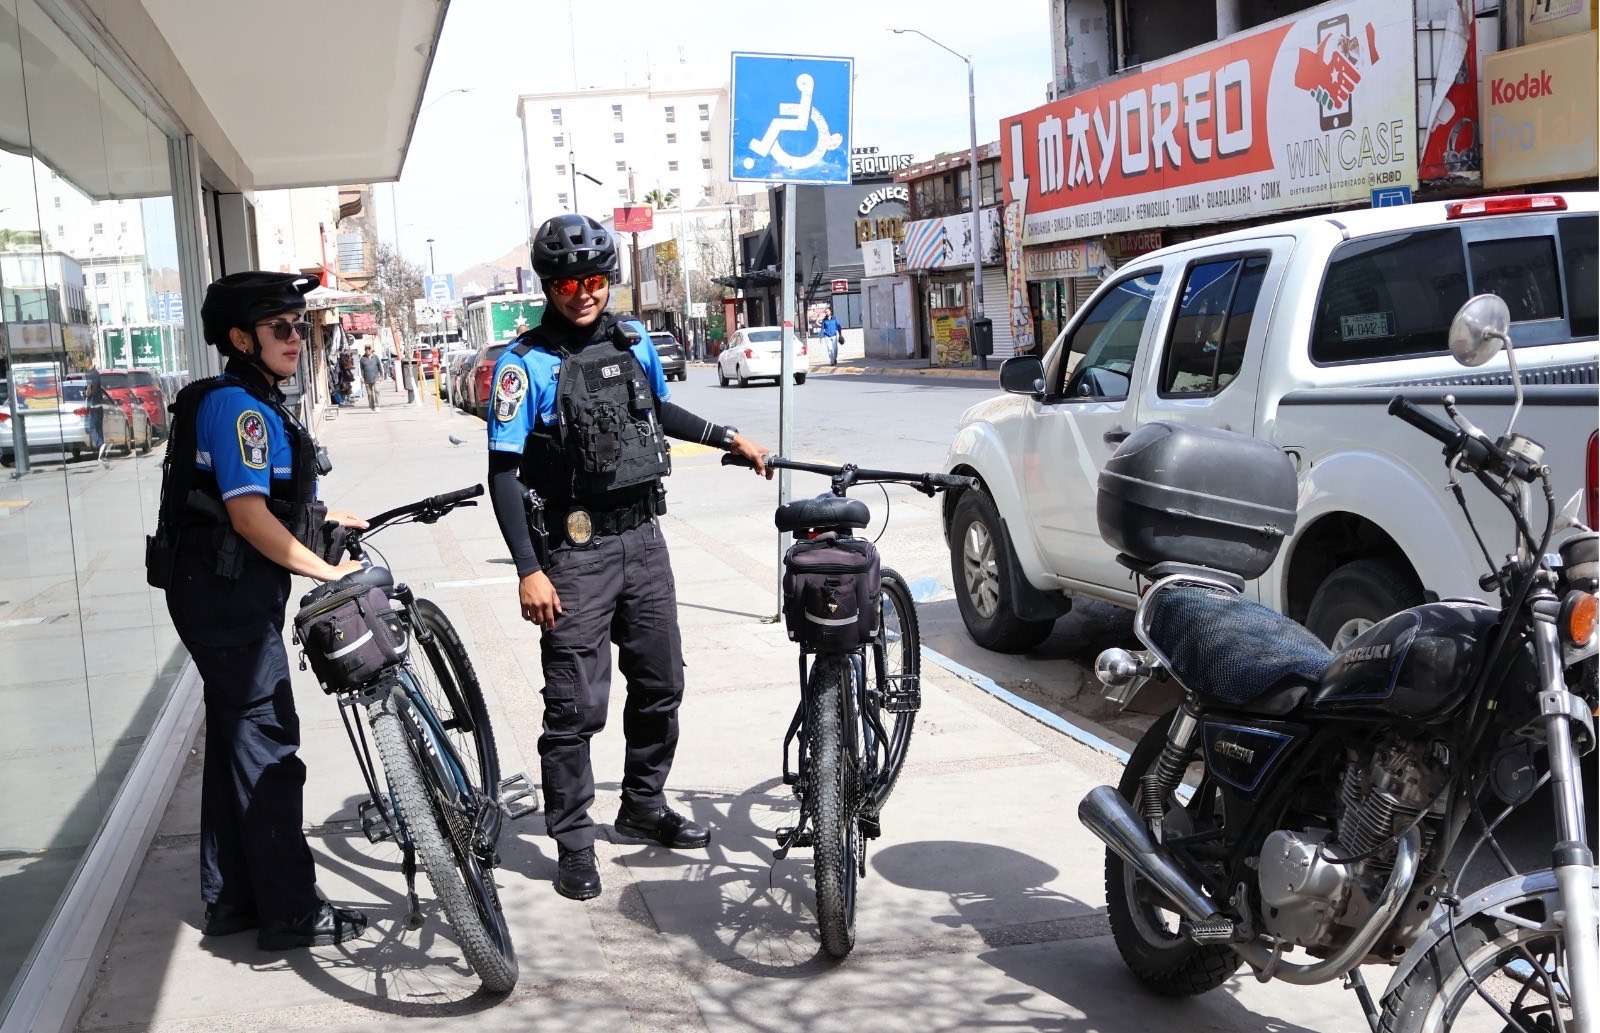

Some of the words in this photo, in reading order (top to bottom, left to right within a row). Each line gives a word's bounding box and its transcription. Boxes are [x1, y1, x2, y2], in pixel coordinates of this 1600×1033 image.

[1491, 69, 1552, 105] Kodak
[1038, 58, 1252, 195] MAYOREO
[1287, 134, 1330, 180] WIN
[1338, 119, 1404, 170] CASE
[1054, 217, 1072, 232] SINALOA
[1075, 214, 1089, 228] NUEVO
[1106, 206, 1130, 224] COAHUILA
[1136, 200, 1170, 219] HERMOSILLO
[1176, 195, 1200, 213] TIJUANA
[1206, 184, 1250, 208] GUADALAJARA
[1261, 181, 1281, 200] CDMX
[1344, 644, 1391, 664] SUZUKI
